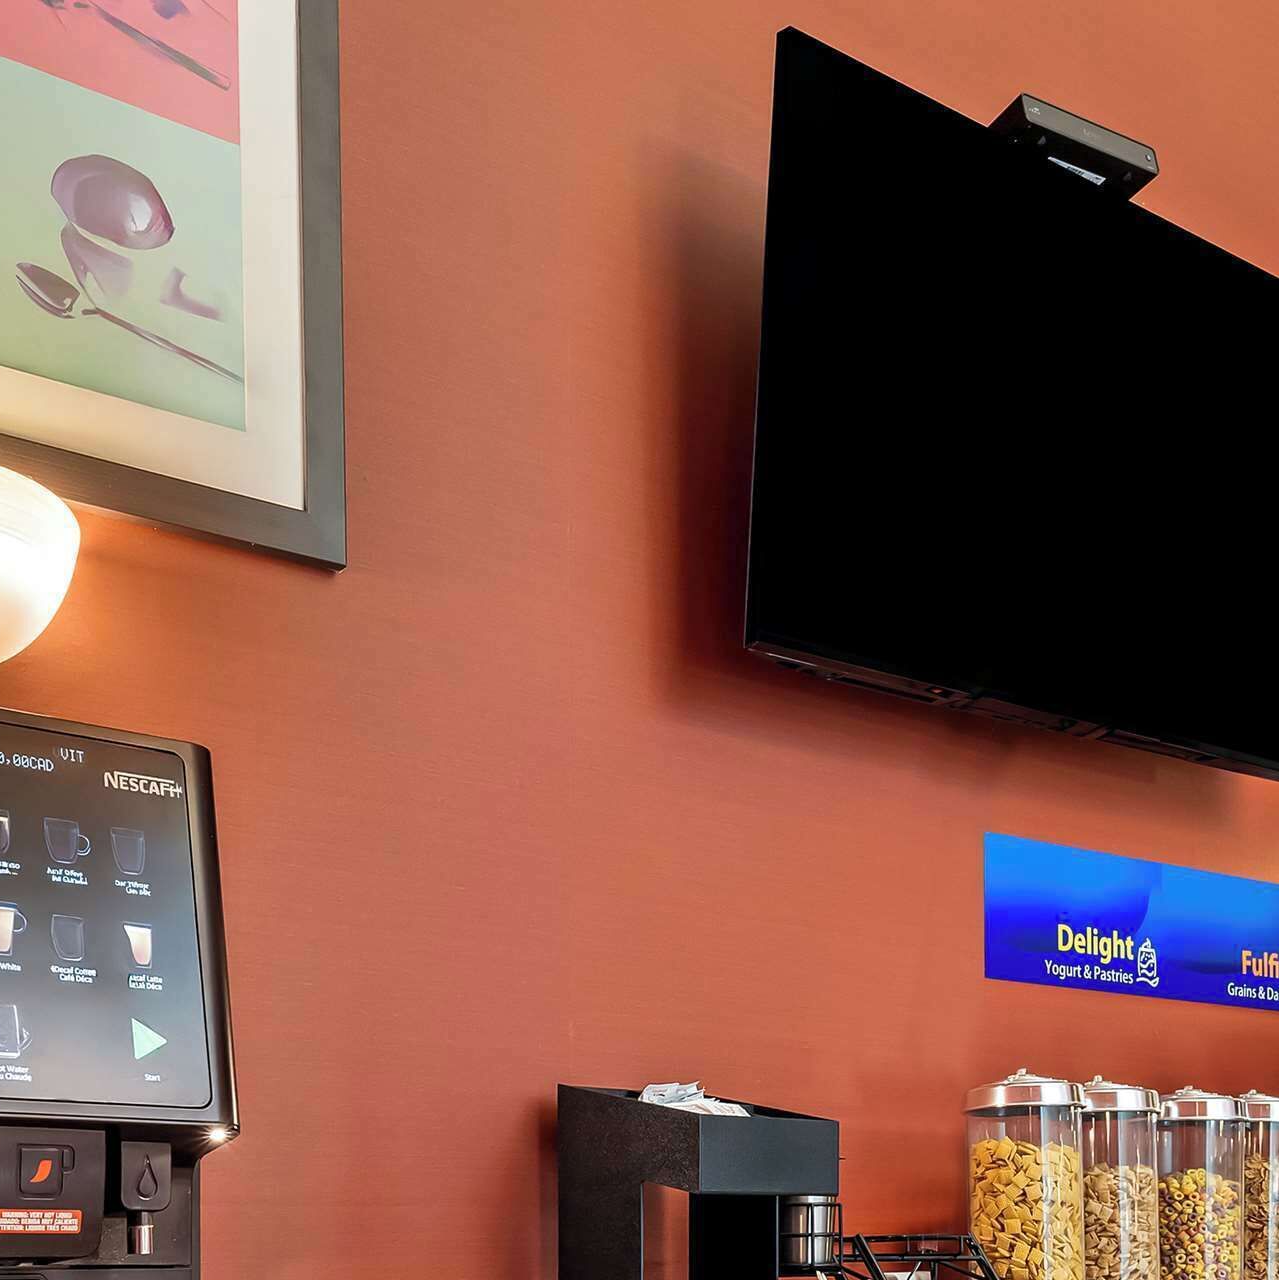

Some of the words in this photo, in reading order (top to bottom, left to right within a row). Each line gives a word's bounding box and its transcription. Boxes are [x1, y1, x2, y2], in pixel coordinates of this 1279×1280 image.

[1057, 923, 1134, 964] Delight
[0, 962, 22, 972] White
[1044, 959, 1082, 980] Yogurt
[1083, 965, 1092, 979] &
[1094, 965, 1134, 985] Pastries
[1227, 982, 1257, 999] Grains
[1258, 986, 1266, 1000] &
[144, 1073, 161, 1083] Start
